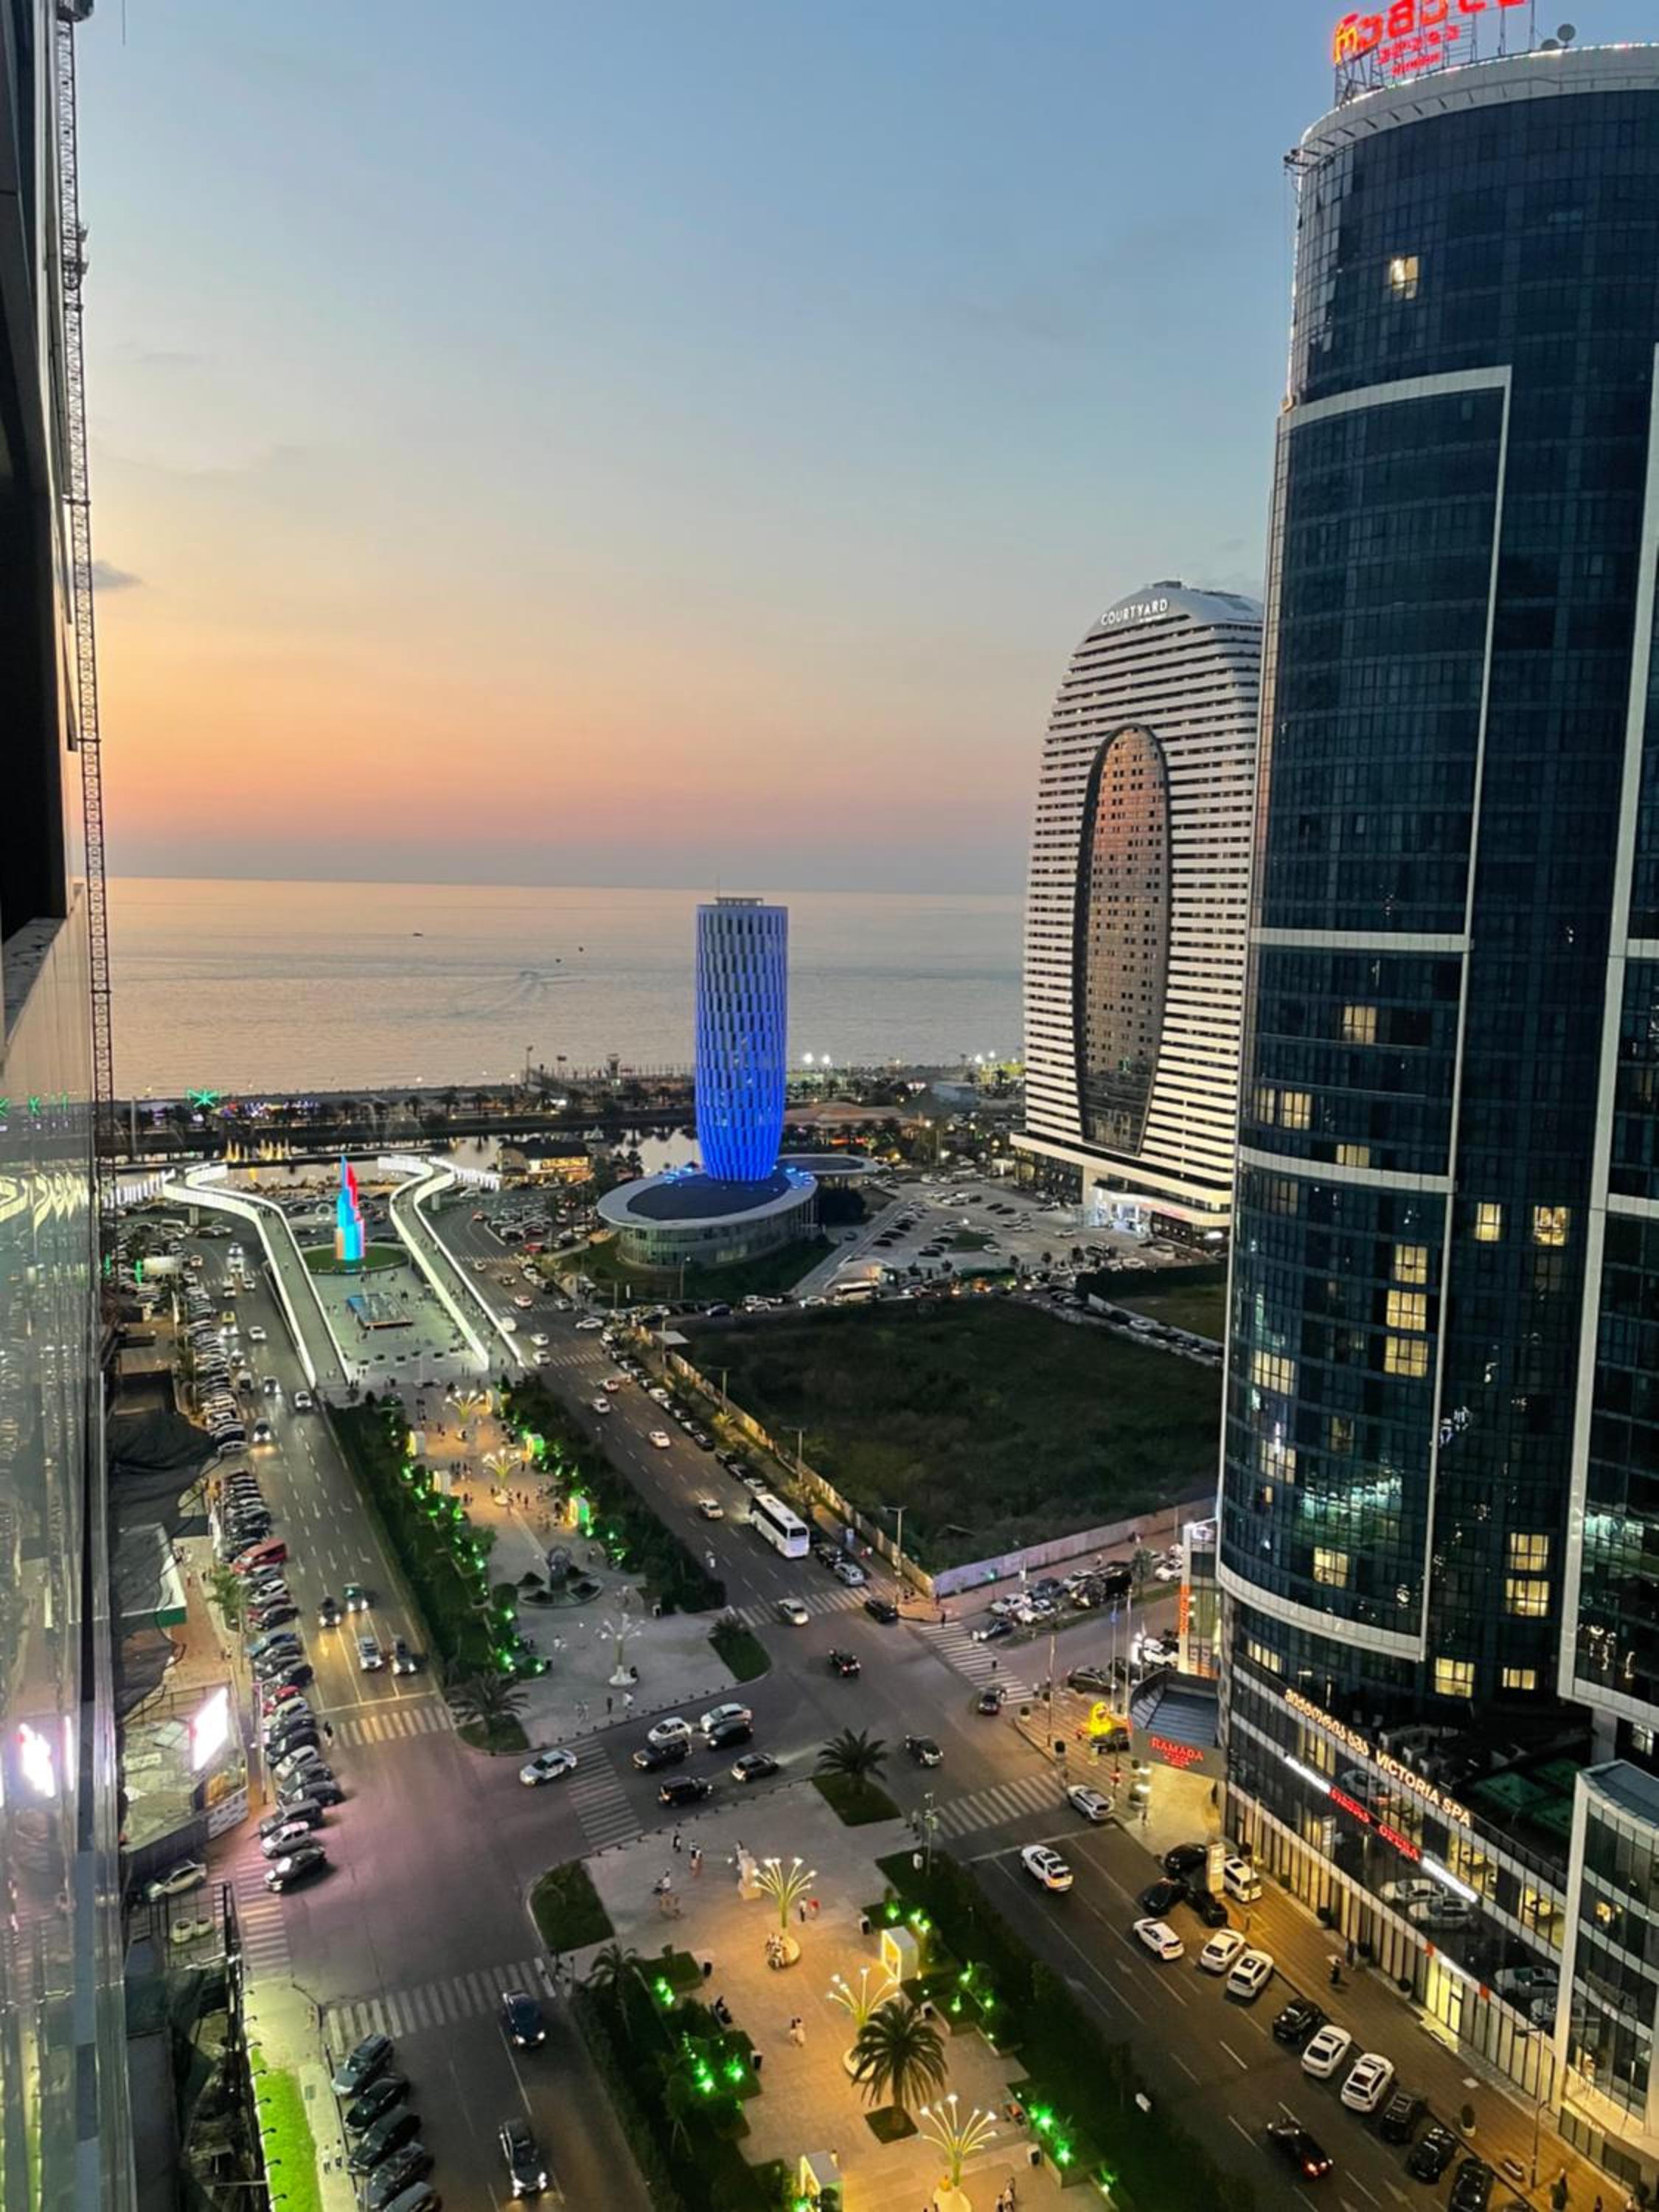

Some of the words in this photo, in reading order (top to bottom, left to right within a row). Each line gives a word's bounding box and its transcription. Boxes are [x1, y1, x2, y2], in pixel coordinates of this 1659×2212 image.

[1101, 599, 1168, 625] COURTYARD
[1151, 1736, 1204, 1761] RAMADA
[1376, 1750, 1439, 1805] VICTORIA
[1442, 1798, 1470, 1827] SPA
